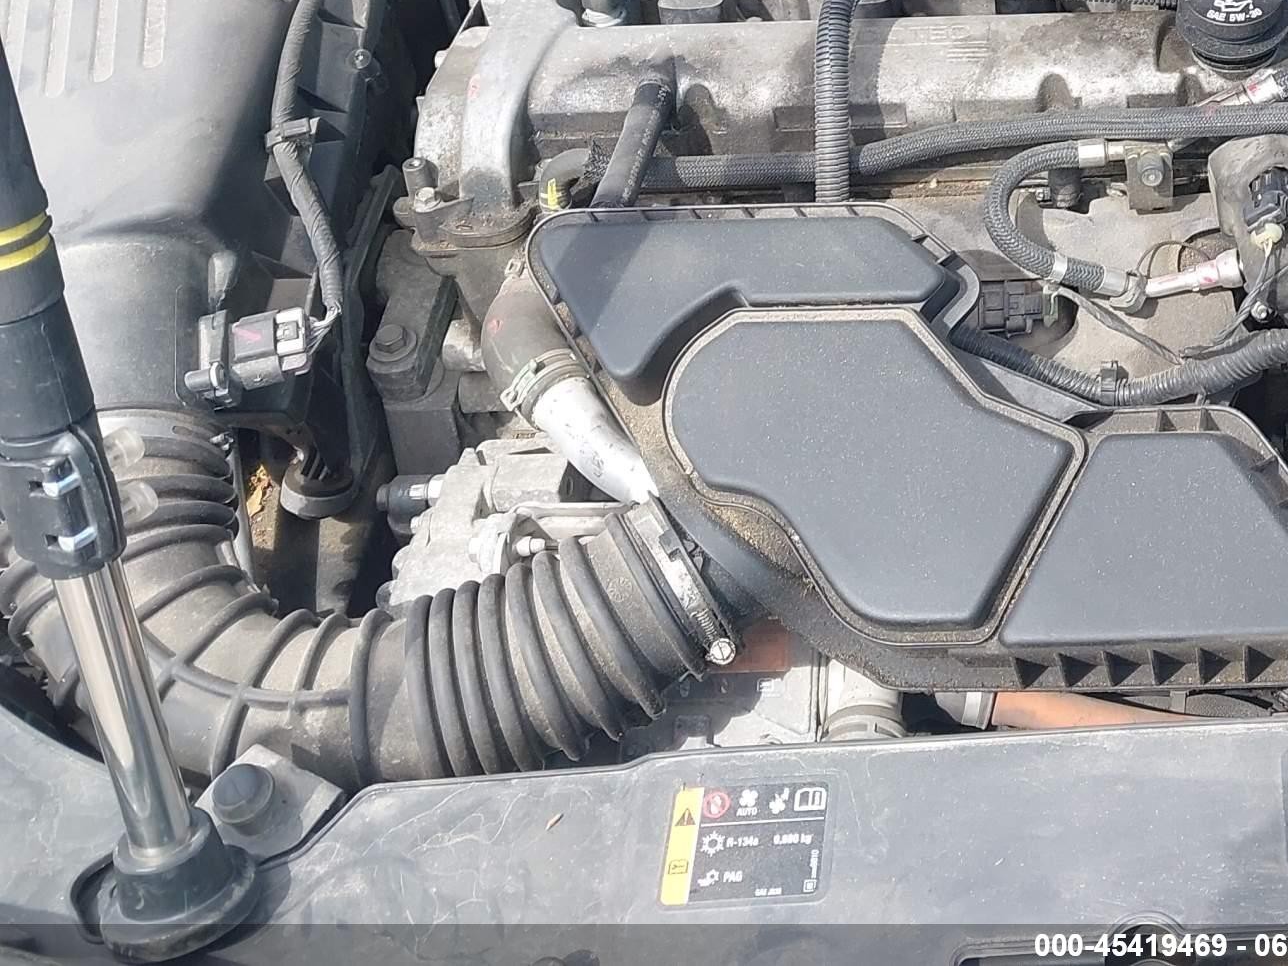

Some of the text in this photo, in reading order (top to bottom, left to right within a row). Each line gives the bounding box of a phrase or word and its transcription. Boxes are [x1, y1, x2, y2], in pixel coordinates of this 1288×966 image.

[1207, 8, 1263, 22] SAE 5W-30
[736, 807, 758, 817] AUTO
[726, 835, 759, 848] R-134a
[801, 833, 814, 845] kg
[723, 870, 743, 883] PAG
